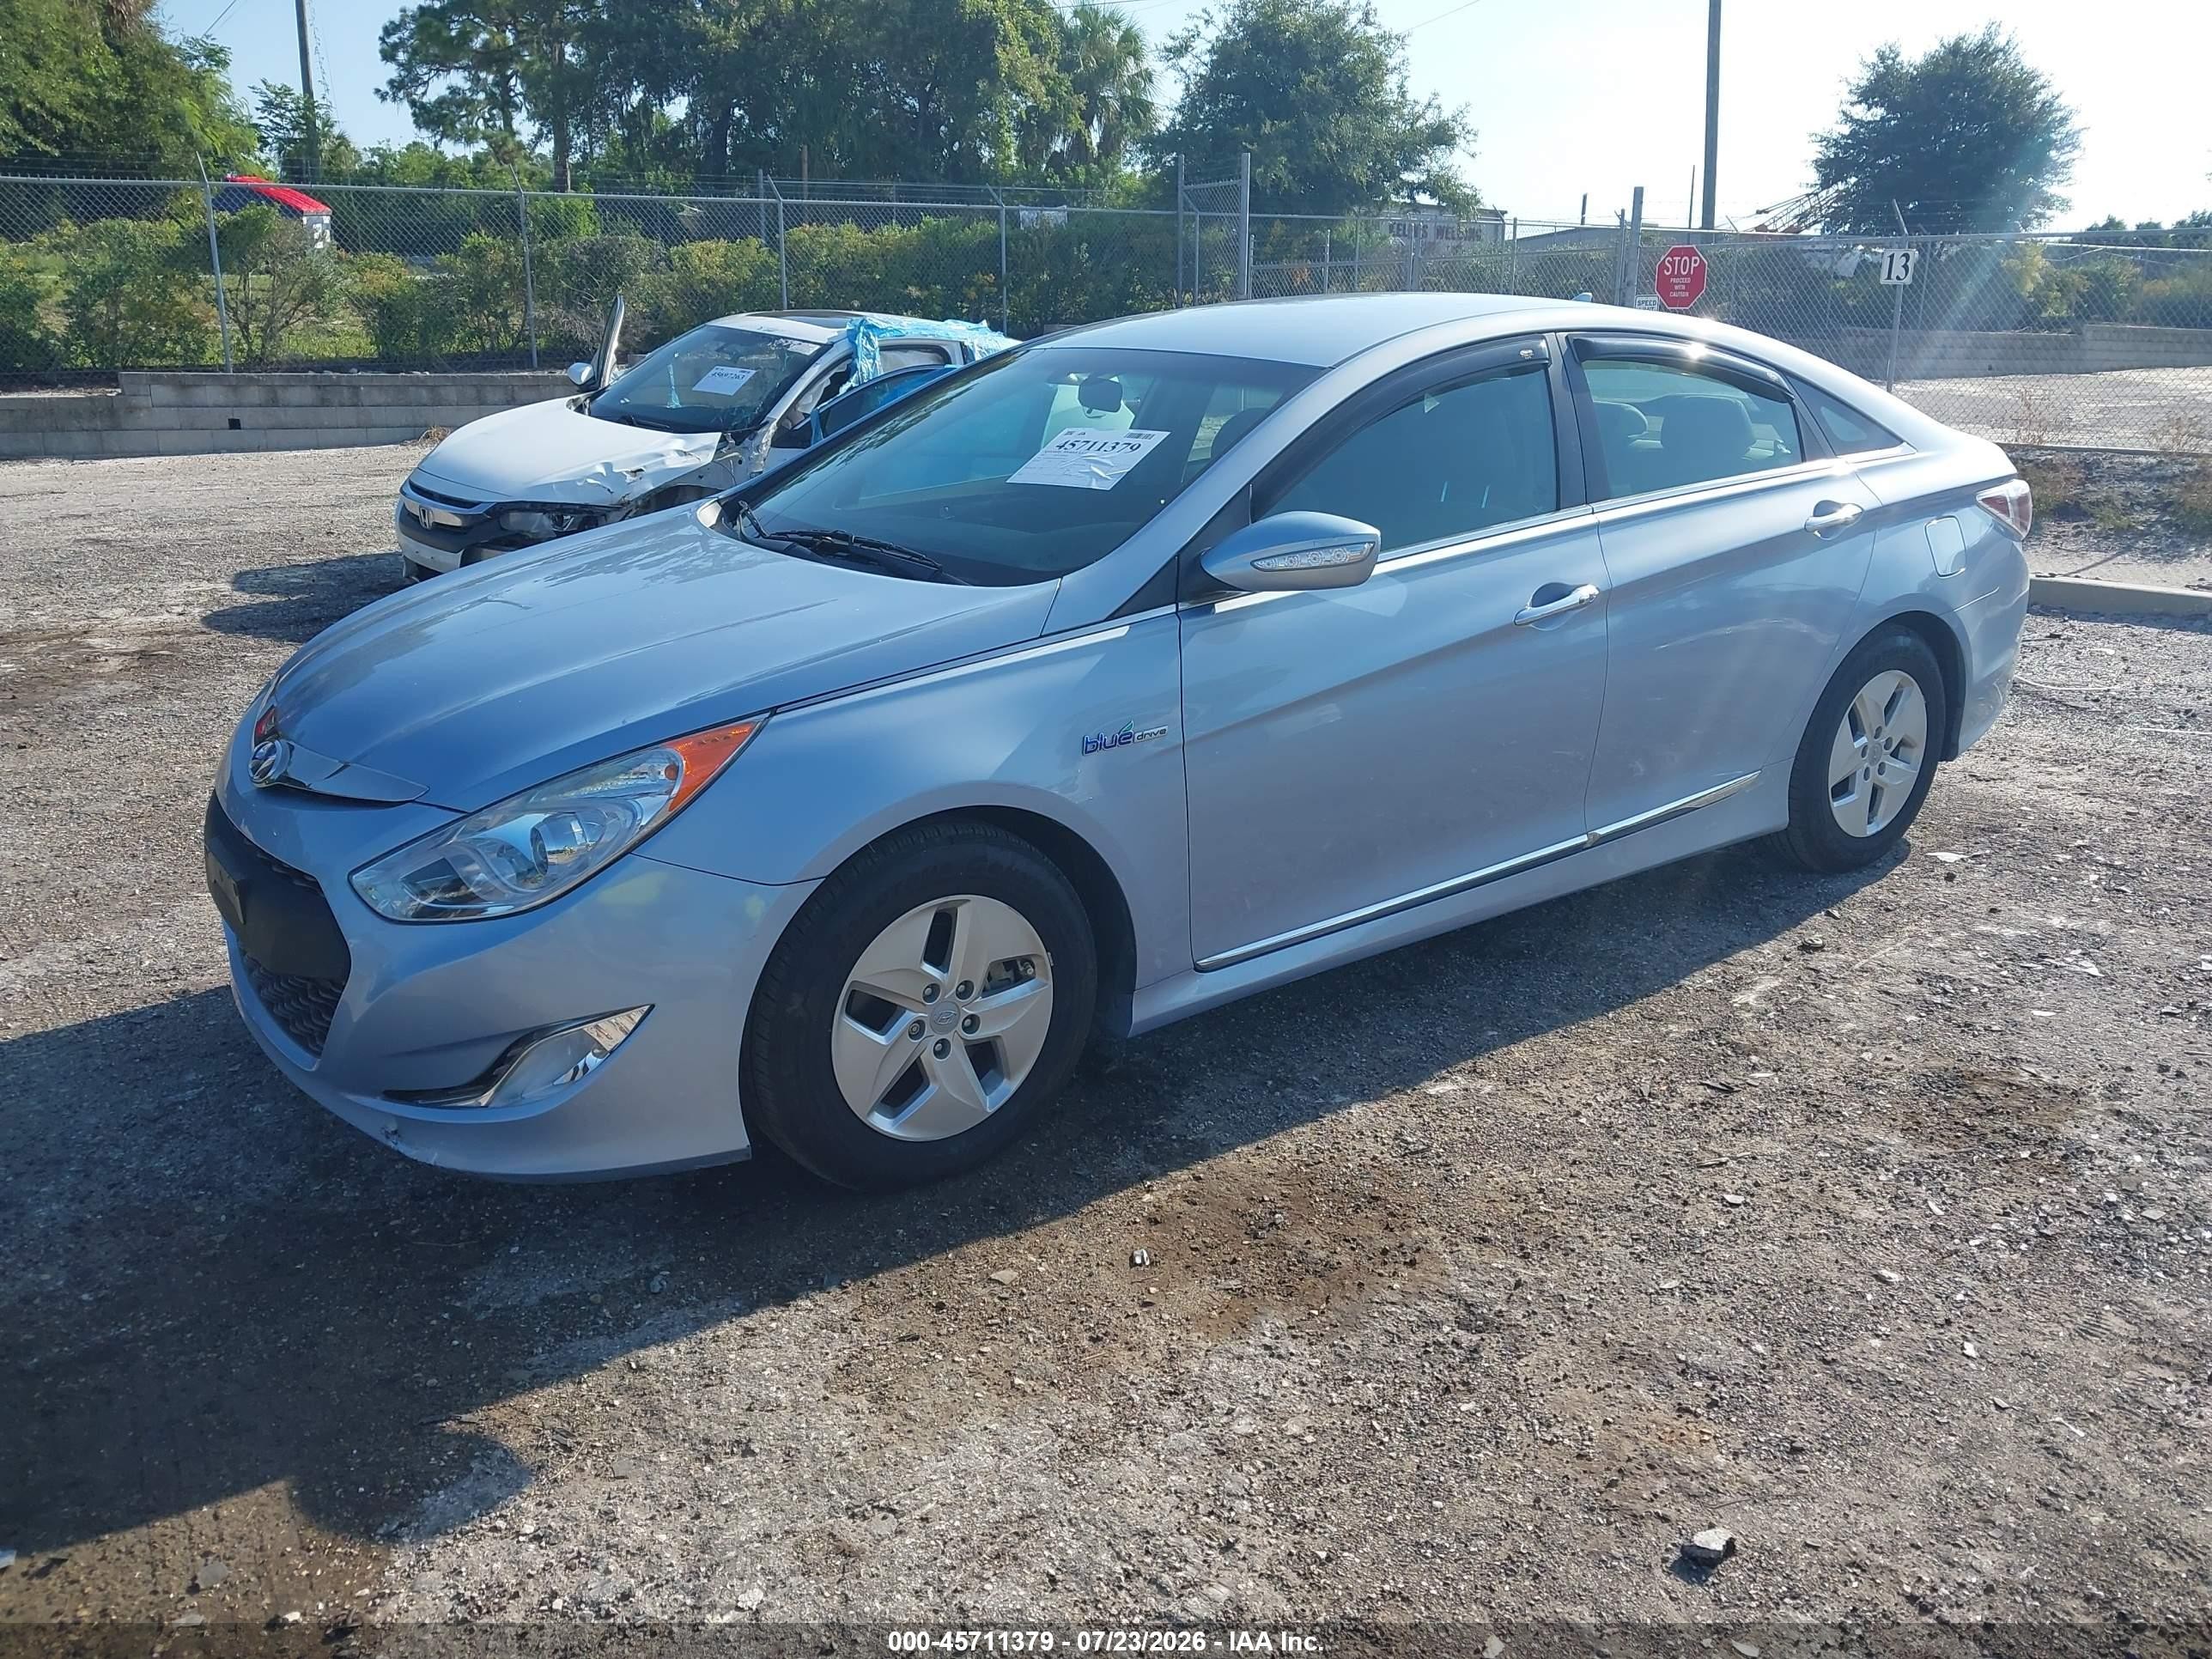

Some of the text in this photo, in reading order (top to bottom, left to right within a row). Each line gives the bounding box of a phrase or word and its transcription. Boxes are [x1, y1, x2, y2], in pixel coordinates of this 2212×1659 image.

[1663, 256, 1700, 276] STOP
[1883, 252, 1911, 281] 13
[1054, 439, 1142, 454] 45711379
[1083, 728, 1168, 756] blue drive
